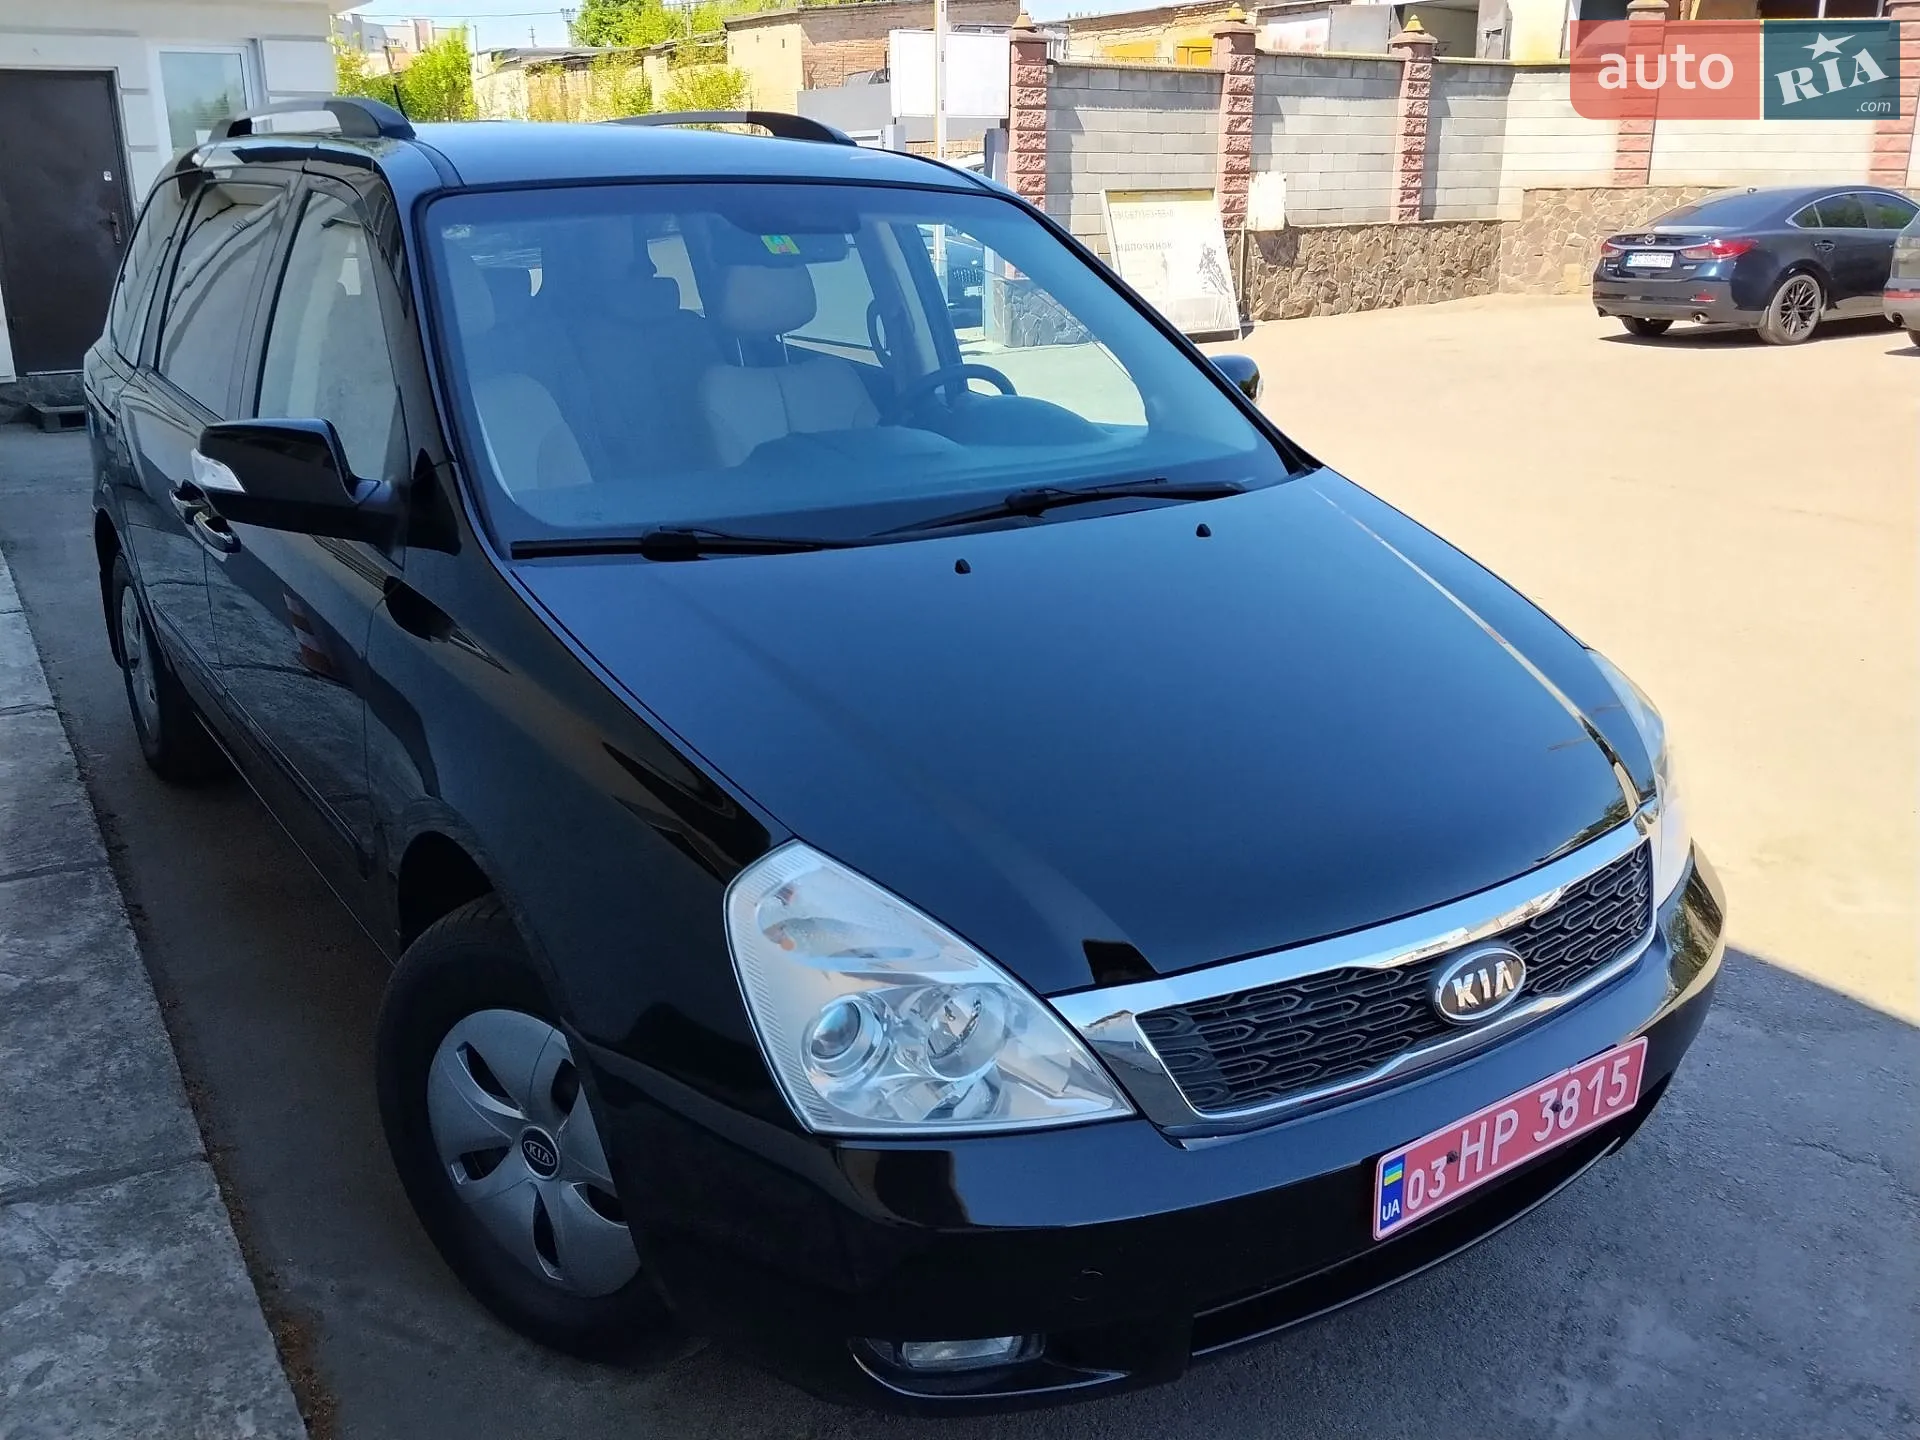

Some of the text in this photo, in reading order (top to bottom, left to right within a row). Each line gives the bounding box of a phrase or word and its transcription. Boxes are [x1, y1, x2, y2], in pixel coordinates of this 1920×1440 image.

[1451, 960, 1515, 1009] KIA
[1533, 1055, 1630, 1142] 3815
[529, 1143, 550, 1164] KIA
[1381, 1198, 1400, 1221] UA
